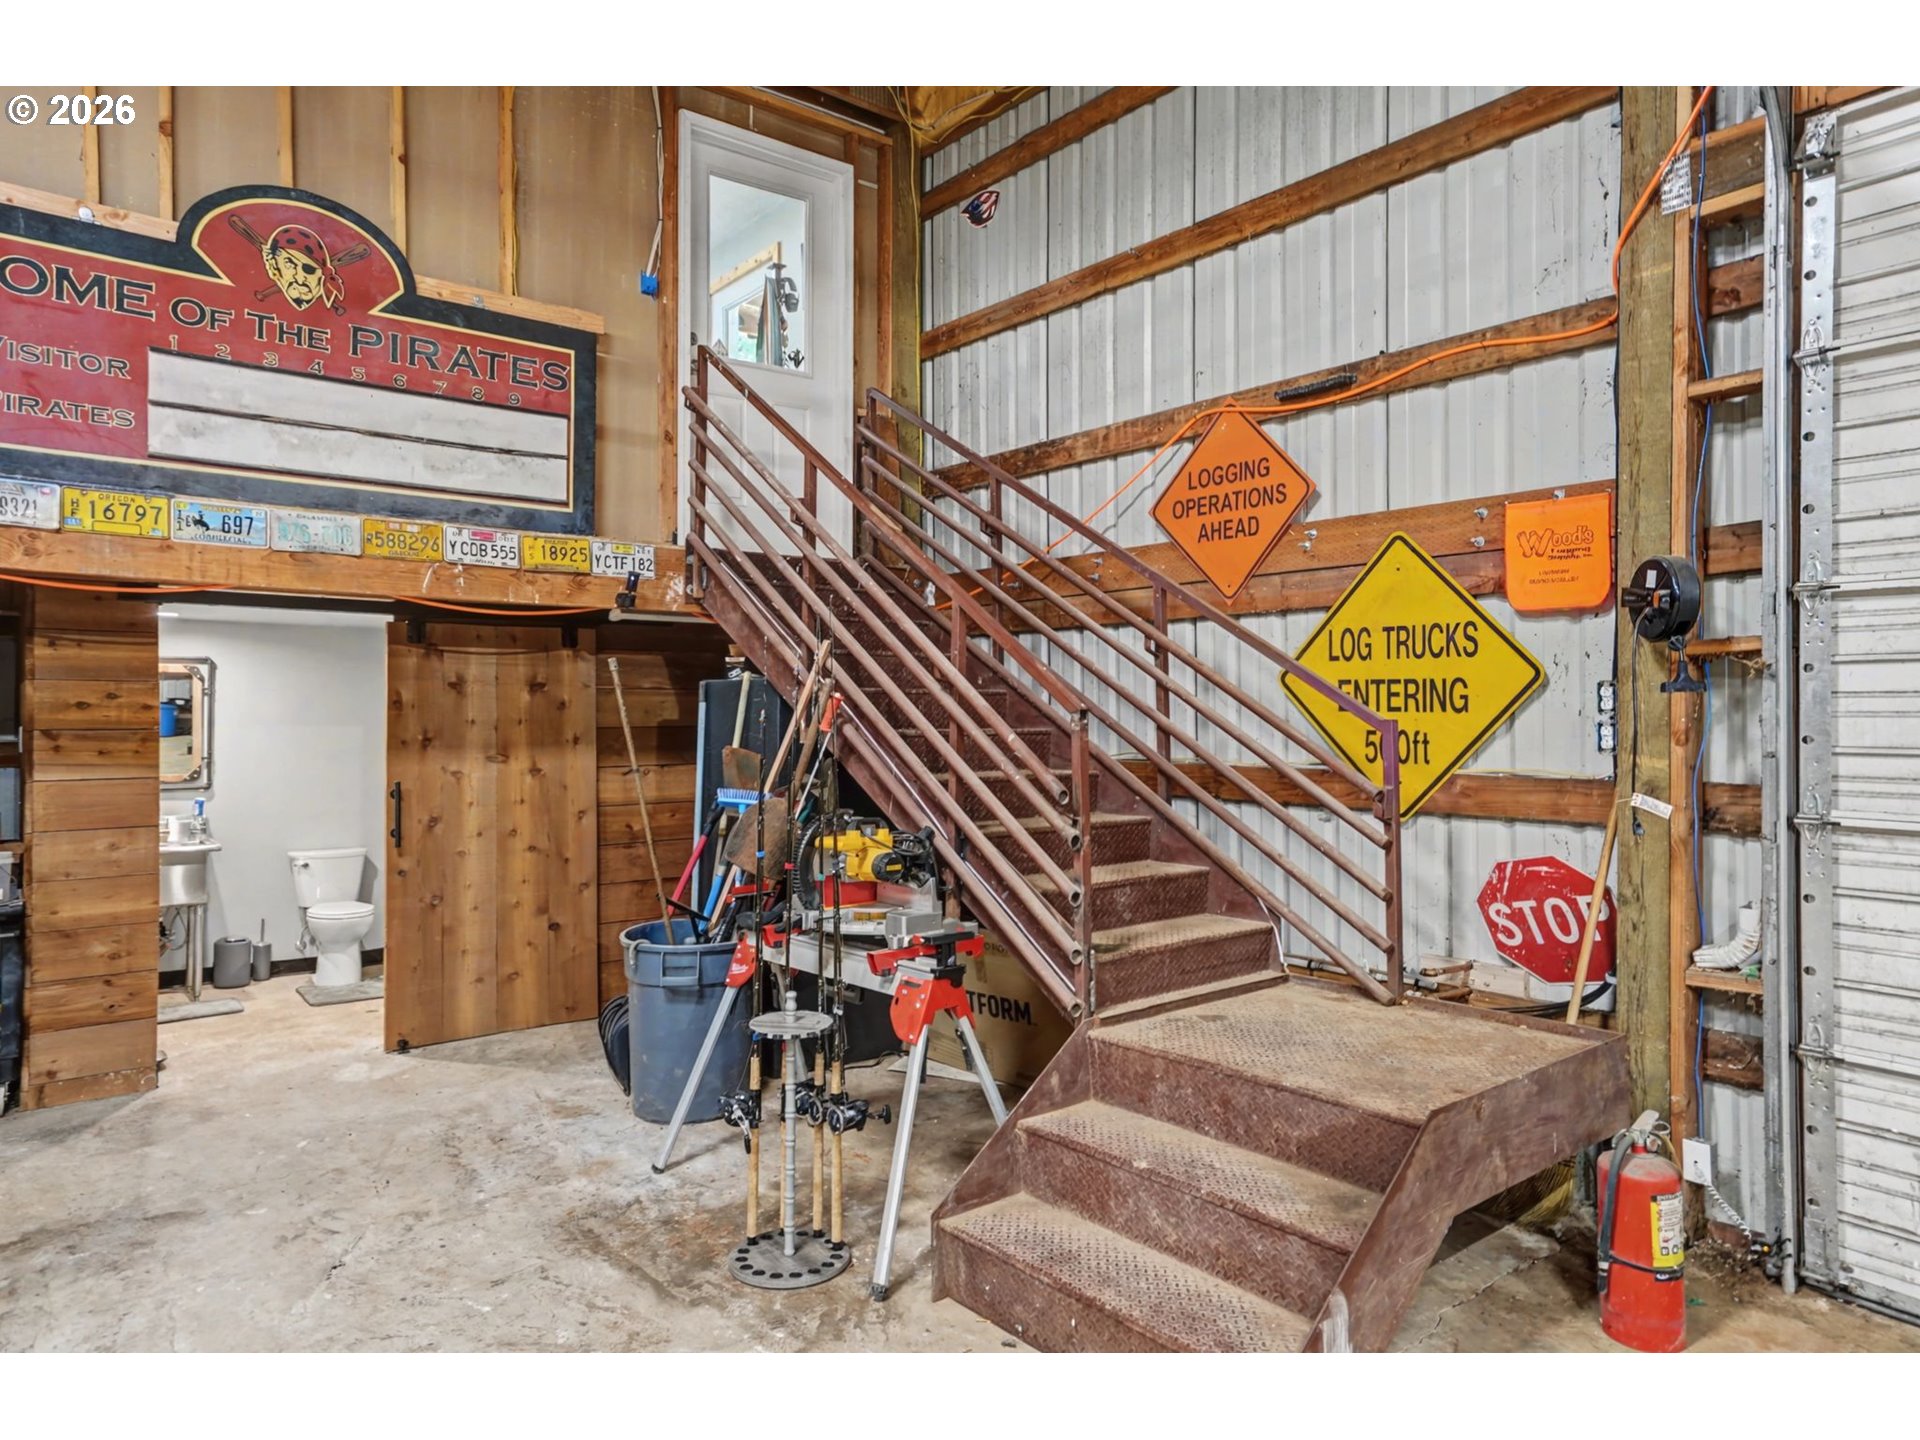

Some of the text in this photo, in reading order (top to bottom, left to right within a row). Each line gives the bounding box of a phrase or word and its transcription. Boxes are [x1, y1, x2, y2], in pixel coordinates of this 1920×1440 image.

[169, 297, 234, 331] OF
[245, 308, 331, 353] THE
[349, 324, 571, 392] PIRATES
[169, 334, 521, 406] 1 2 3 4 5 6 7 8 9
[0, 391, 135, 428] IRATES
[1187, 456, 1271, 491] LOGGING
[89, 499, 163, 525] 16797
[1172, 483, 1287, 520] OPERATIONS
[222, 514, 254, 536] 697
[1197, 515, 1260, 544] AHEAD
[1516, 525, 1594, 558] Wood's
[541, 544, 588, 563] 18925
[1328, 620, 1479, 662] LOG TRUCKS
[1337, 677, 1469, 714] ENTERING
[1364, 729, 1430, 765] 50ft
[1488, 895, 1610, 947] STOP
[966, 990, 1032, 1026] TFORM
